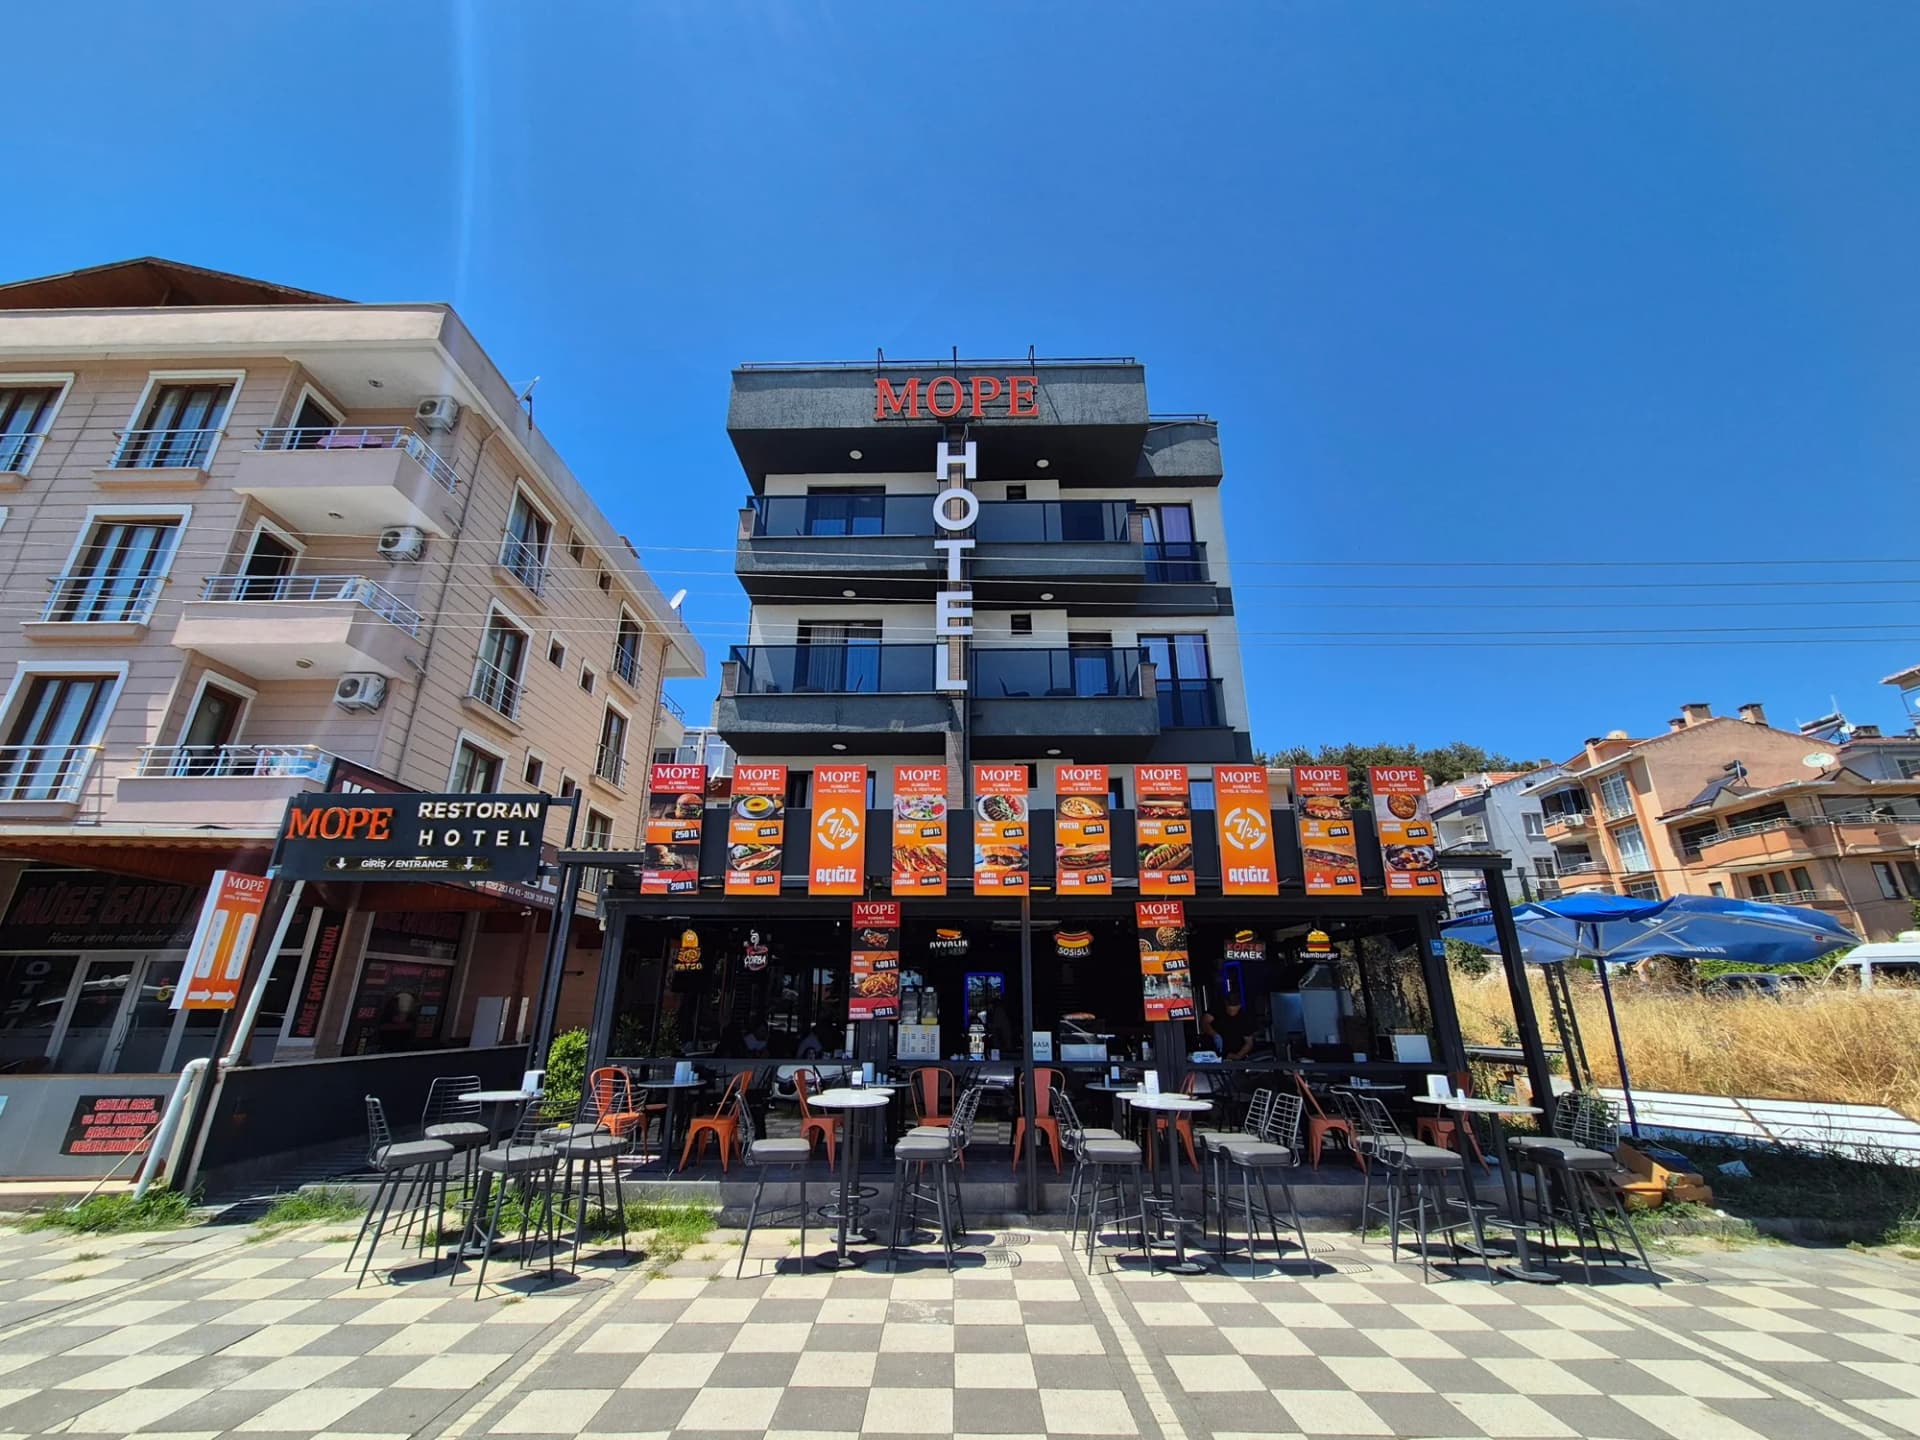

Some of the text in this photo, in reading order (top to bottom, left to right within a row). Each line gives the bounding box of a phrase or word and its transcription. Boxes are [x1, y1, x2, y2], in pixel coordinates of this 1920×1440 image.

[874, 376, 1038, 420] MOPE
[933, 441, 980, 691] HOTEL
[657, 767, 701, 779] MOPE
[738, 769, 781, 781] MOPE
[819, 771, 861, 783] MOPE
[899, 769, 941, 781] MOPE
[980, 769, 1022, 781] MOPE
[1061, 769, 1102, 780] MOPE
[1140, 769, 1182, 780] MOPE
[1220, 771, 1261, 783] MOPE
[1300, 769, 1341, 781] MOPE
[1375, 770, 1418, 781] MOPE
[418, 802, 540, 819] RESTORAN
[285, 806, 394, 840] MOPE
[826, 818, 853, 840] 7/24
[1233, 818, 1260, 840] 7/24
[418, 829, 531, 847] HOTEL
[675, 830, 689, 839] 250
[361, 858, 387, 870] GİRİŞ
[395, 859, 449, 868] ENTRANCE
[816, 866, 857, 886] AÇIĞIZ
[1228, 866, 1270, 886] AÇIĞIZ
[227, 876, 265, 892] MOPE
[671, 882, 685, 890] 200
[857, 904, 896, 915] MOPE
[1140, 903, 1180, 915] MOPE
[1226, 951, 1264, 960] EKMEK
[1300, 951, 1339, 961] Hamburger
[1166, 961, 1177, 969] 150
[1171, 1009, 1183, 1017] 200
